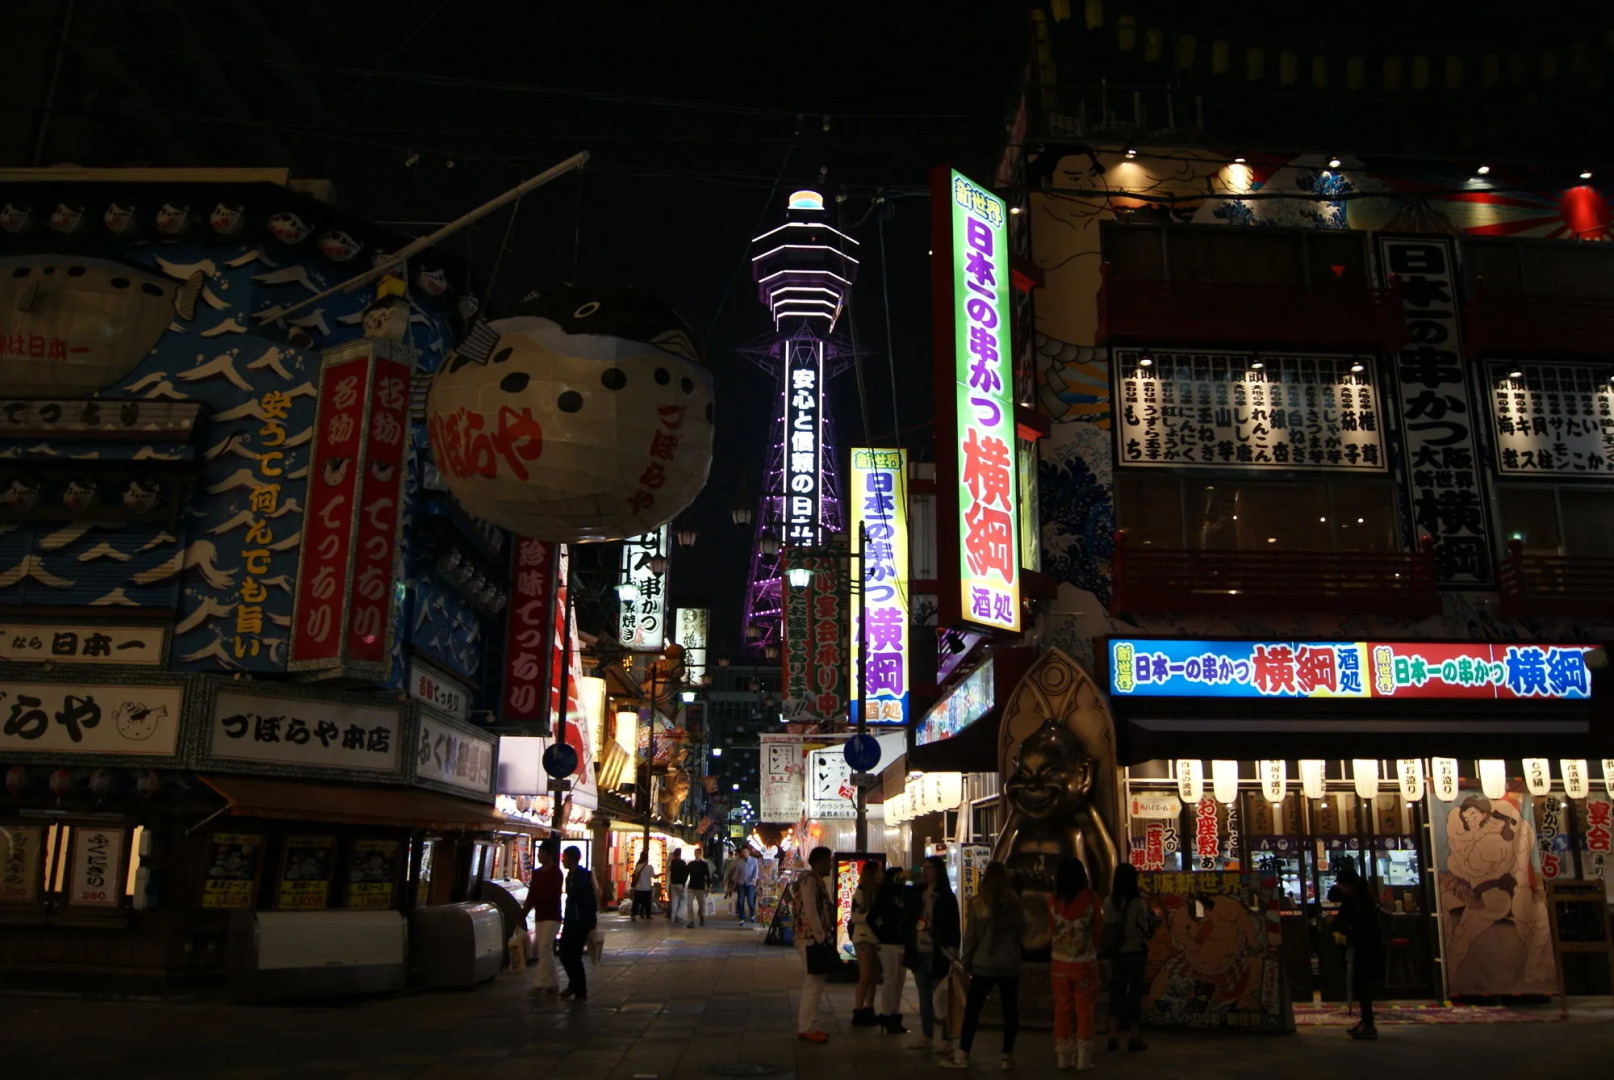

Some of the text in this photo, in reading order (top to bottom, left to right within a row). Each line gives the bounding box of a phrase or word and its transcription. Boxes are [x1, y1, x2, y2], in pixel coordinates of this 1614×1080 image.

[954, 179, 1004, 229] 新世界
[966, 216, 1003, 428] 日本一の串かつ
[1389, 242, 1471, 446] 日本一の串かつ
[329, 375, 360, 444] 名物
[1124, 405, 1142, 460] もち
[1143, 405, 1162, 460] うずら玉子
[1178, 408, 1197, 461] にんにく
[1197, 408, 1216, 462] 玉ねぎ
[1215, 409, 1235, 462] 山芋
[1234, 408, 1253, 462] しし唐
[1252, 409, 1272, 463] れんこん
[1269, 409, 1289, 463] 銀杏
[1288, 409, 1307, 463] 白ねぎ
[855, 451, 903, 468] 新世界
[1306, 410, 1324, 463] さつま芋
[1341, 411, 1360, 465] 茄子
[1359, 411, 1378, 465] 椎茸
[1412, 447, 1474, 469] 大阪
[1498, 415, 1519, 469] 海老
[1516, 416, 1537, 469] キス
[1532, 417, 1554, 469] 貝柱
[1549, 417, 1569, 470] サーモン
[1566, 417, 1586, 470] たこ
[1583, 418, 1604, 471] いか
[1415, 470, 1475, 489] 新世界
[234, 391, 293, 658] 安うて何んでも旨い
[961, 428, 1014, 585] 横綱
[864, 471, 895, 600] 日本一の串かつ
[1416, 489, 1487, 581] 横綱
[971, 586, 1014, 625] 酒処
[52, 632, 146, 657] 日本一
[855, 605, 904, 693] 横綱
[1115, 644, 1362, 694] 新世界 日本一の串かつ 横綱 酒処
[1375, 646, 1588, 694] 新世界 日本一の串かつ 横綱
[0, 692, 101, 743] らや
[222, 713, 391, 753] づぼらや本店
[1405, 766, 1416, 794] お造り
[1442, 766, 1453, 794] お造り
[1531, 761, 1544, 788] もつ鍋
[1197, 797, 1219, 870] お座敷あ
[1137, 872, 1243, 894] 大阪新世界
